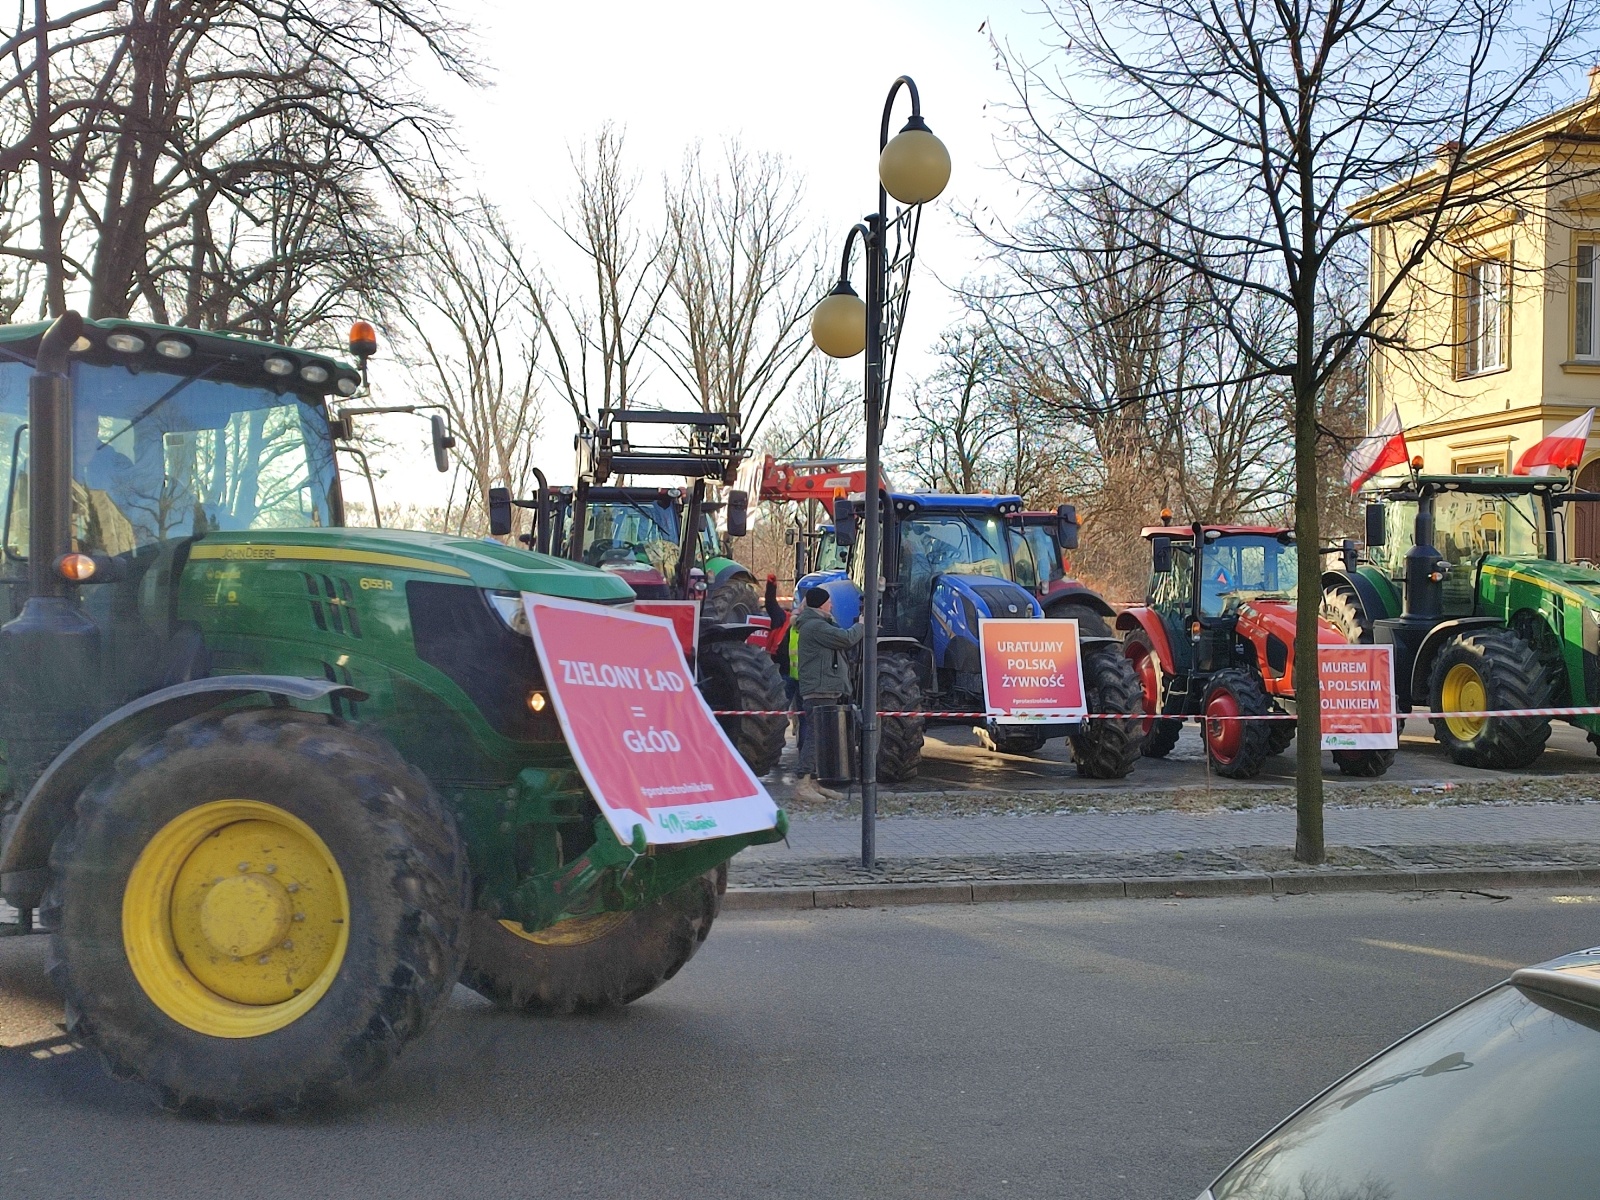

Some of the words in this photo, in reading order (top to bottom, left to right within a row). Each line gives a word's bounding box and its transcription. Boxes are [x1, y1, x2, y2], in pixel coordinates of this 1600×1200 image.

[222, 547, 245, 559] JOHN
[246, 547, 276, 559] DEERE
[997, 641, 1064, 653] URATUJMY
[1007, 659, 1057, 672] POLSKĄ
[1322, 662, 1367, 673] MUREM
[558, 659, 642, 690] ZIELONY
[644, 668, 684, 692] ŁAD
[1002, 674, 1065, 688] ŻYWNOŚĆ
[1319, 680, 1325, 691] A
[1328, 680, 1381, 691] POLSKIM
[1320, 698, 1379, 709] OLNIKIEM
[630, 706, 646, 718] =
[622, 726, 681, 753] GŁÓD
[640, 781, 715, 798] #protestrolników
